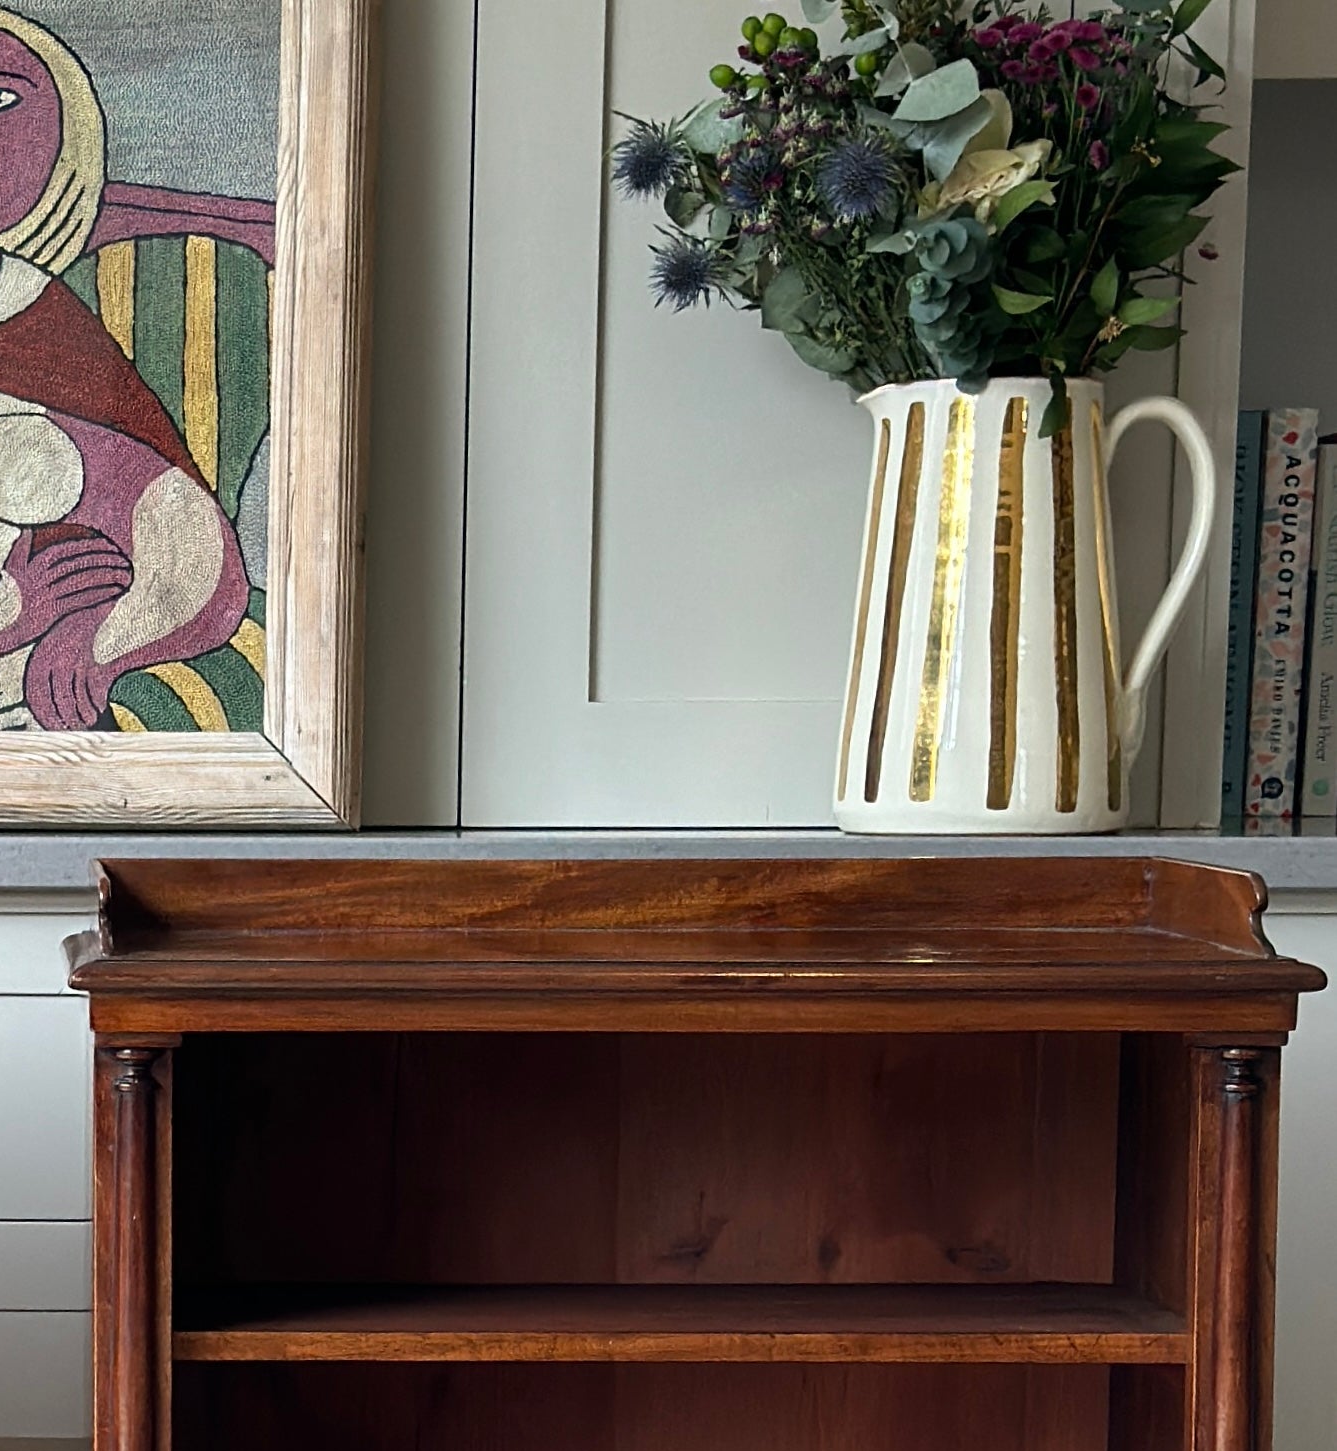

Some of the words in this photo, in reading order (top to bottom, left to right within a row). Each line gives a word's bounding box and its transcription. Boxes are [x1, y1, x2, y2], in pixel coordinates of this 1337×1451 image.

[1275, 455, 1302, 635] ACQUACOTTA
[1272, 658, 1287, 702] EMIKO
[1319, 671, 1334, 720] Amelia
[1270, 708, 1284, 755] DAVIES
